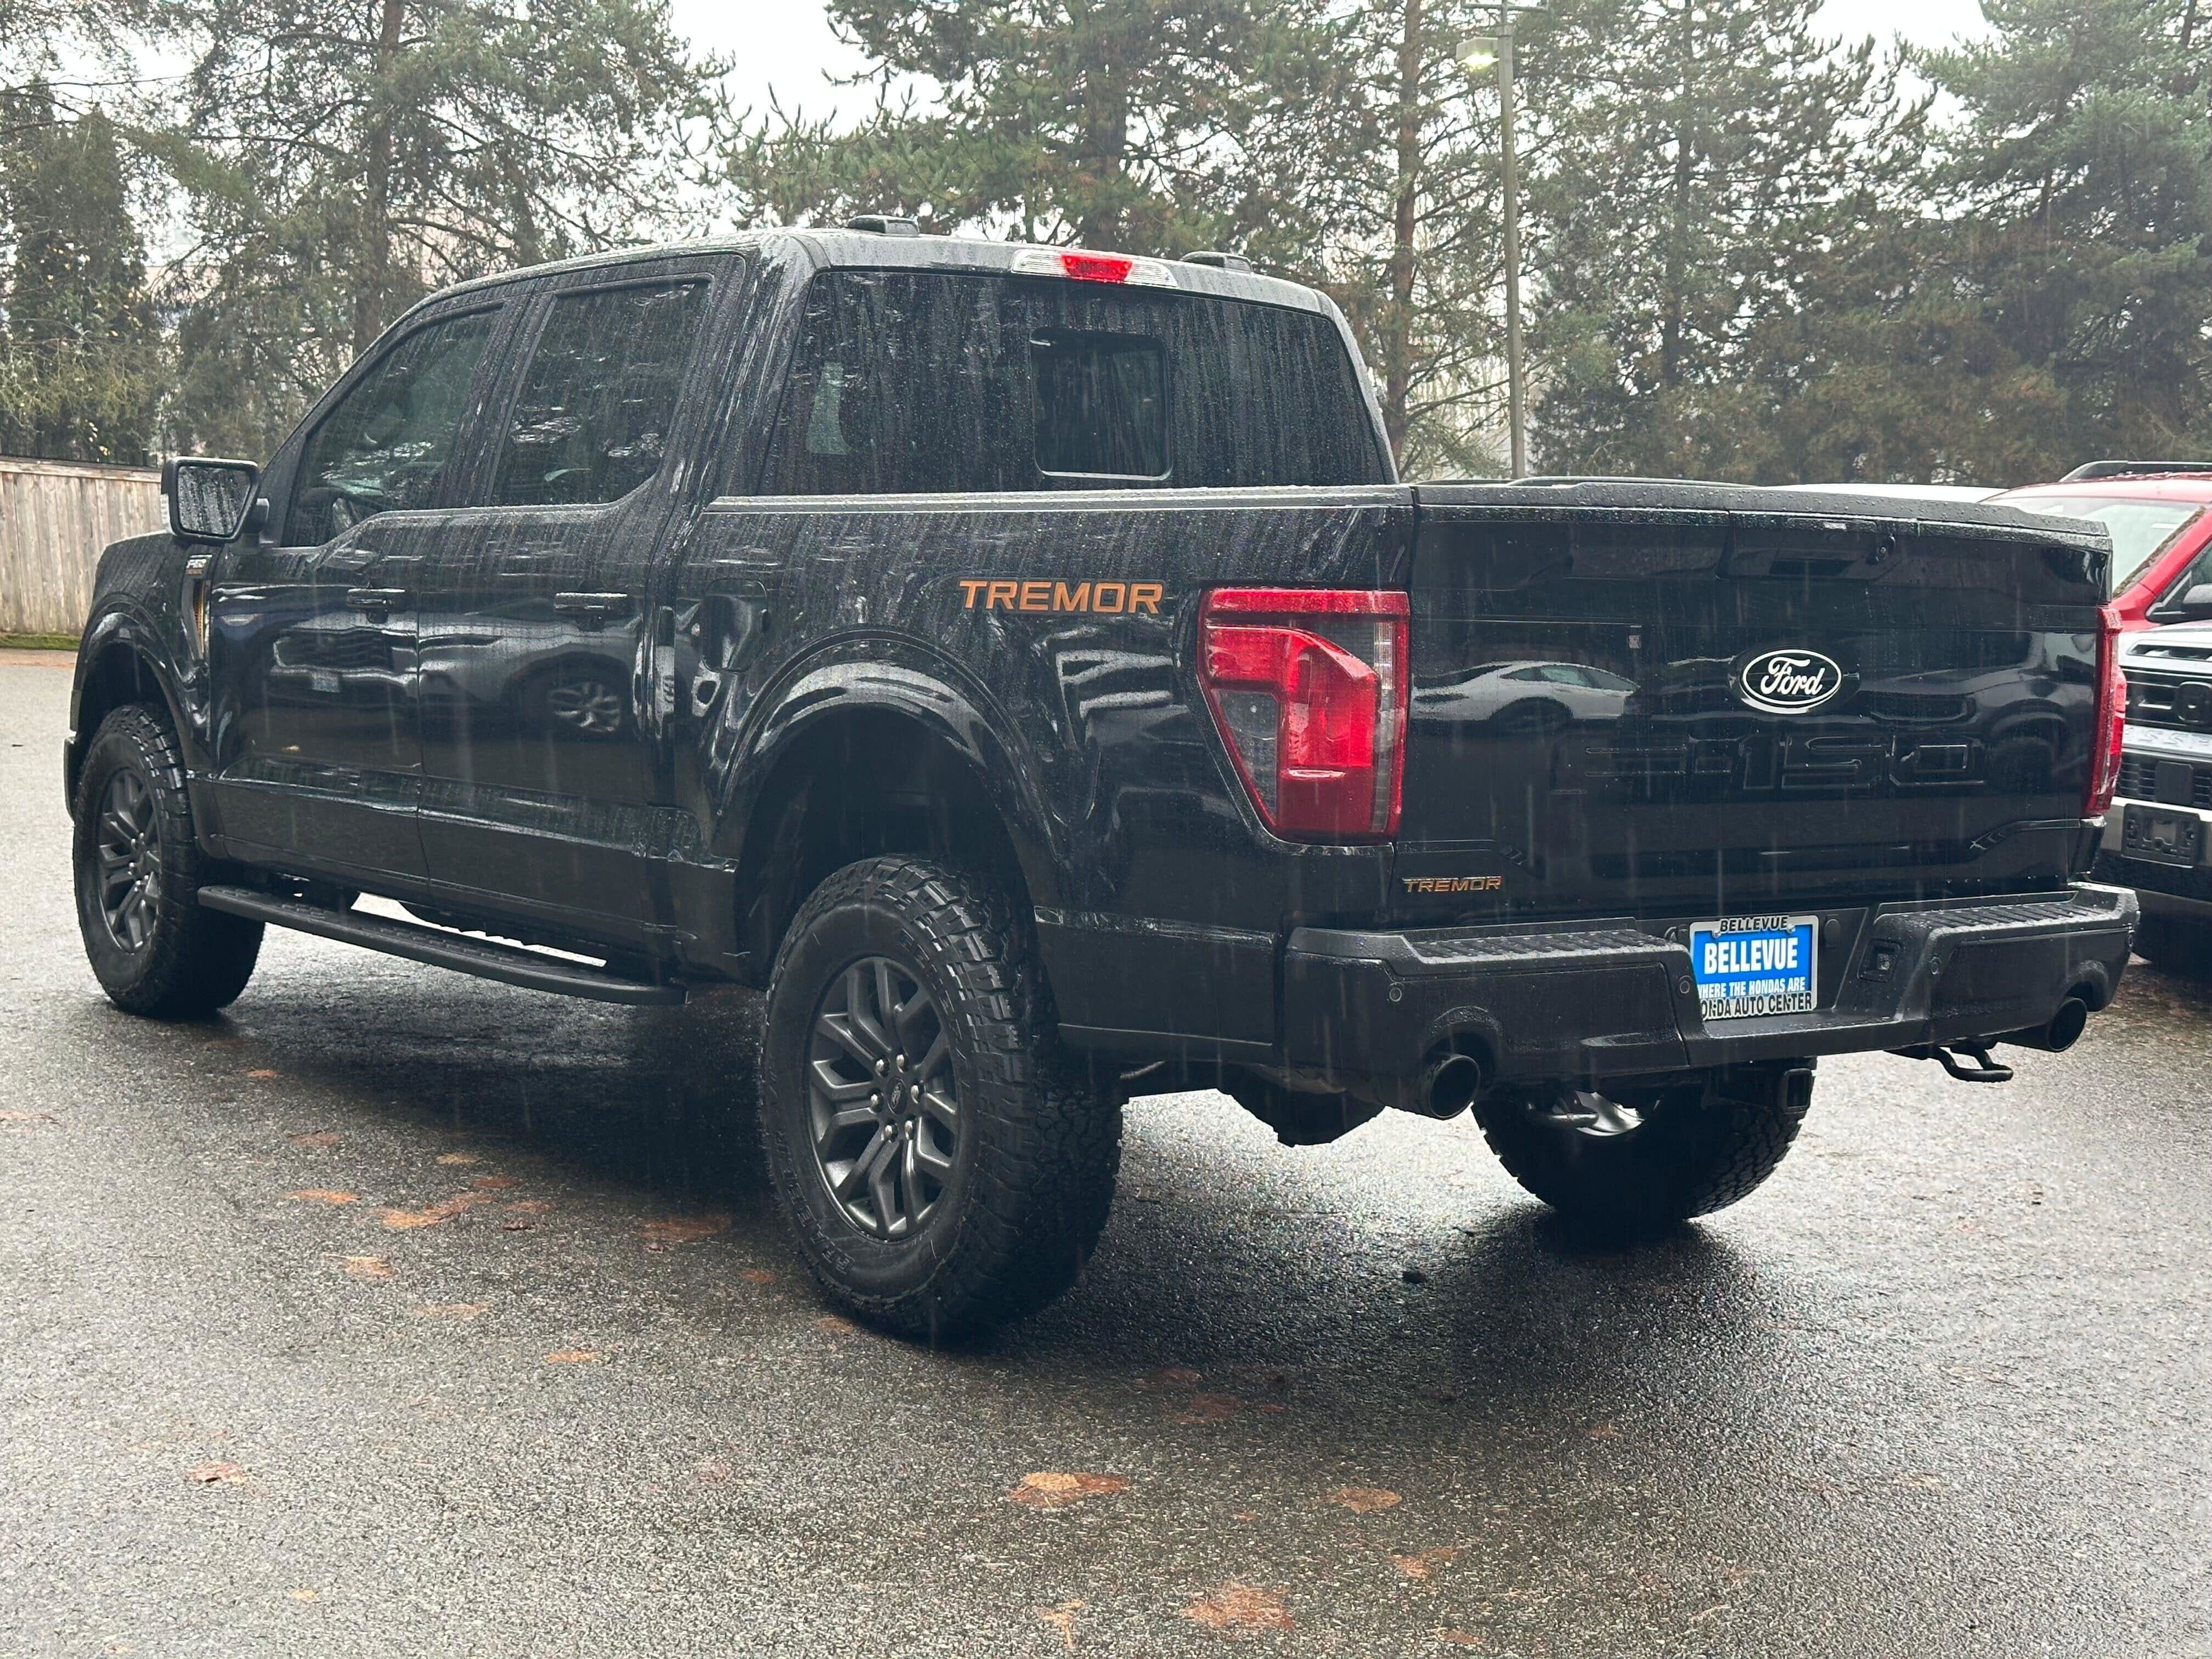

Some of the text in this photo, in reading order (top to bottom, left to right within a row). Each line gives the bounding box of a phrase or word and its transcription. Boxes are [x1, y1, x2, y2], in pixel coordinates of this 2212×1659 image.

[960, 580, 1163, 614] TREMOR
[1760, 657, 1825, 695] Ford
[1402, 876, 1502, 893] TREMOR
[1720, 917, 1788, 932] BELLEVUE
[1705, 938, 1798, 974] BELLEVUE
[1729, 981, 1746, 997] THE
[1748, 978, 1785, 995] HONDAS
[1787, 977, 1805, 992] ARE
[1701, 991, 1812, 1018] ONDA AUTO CENTER
